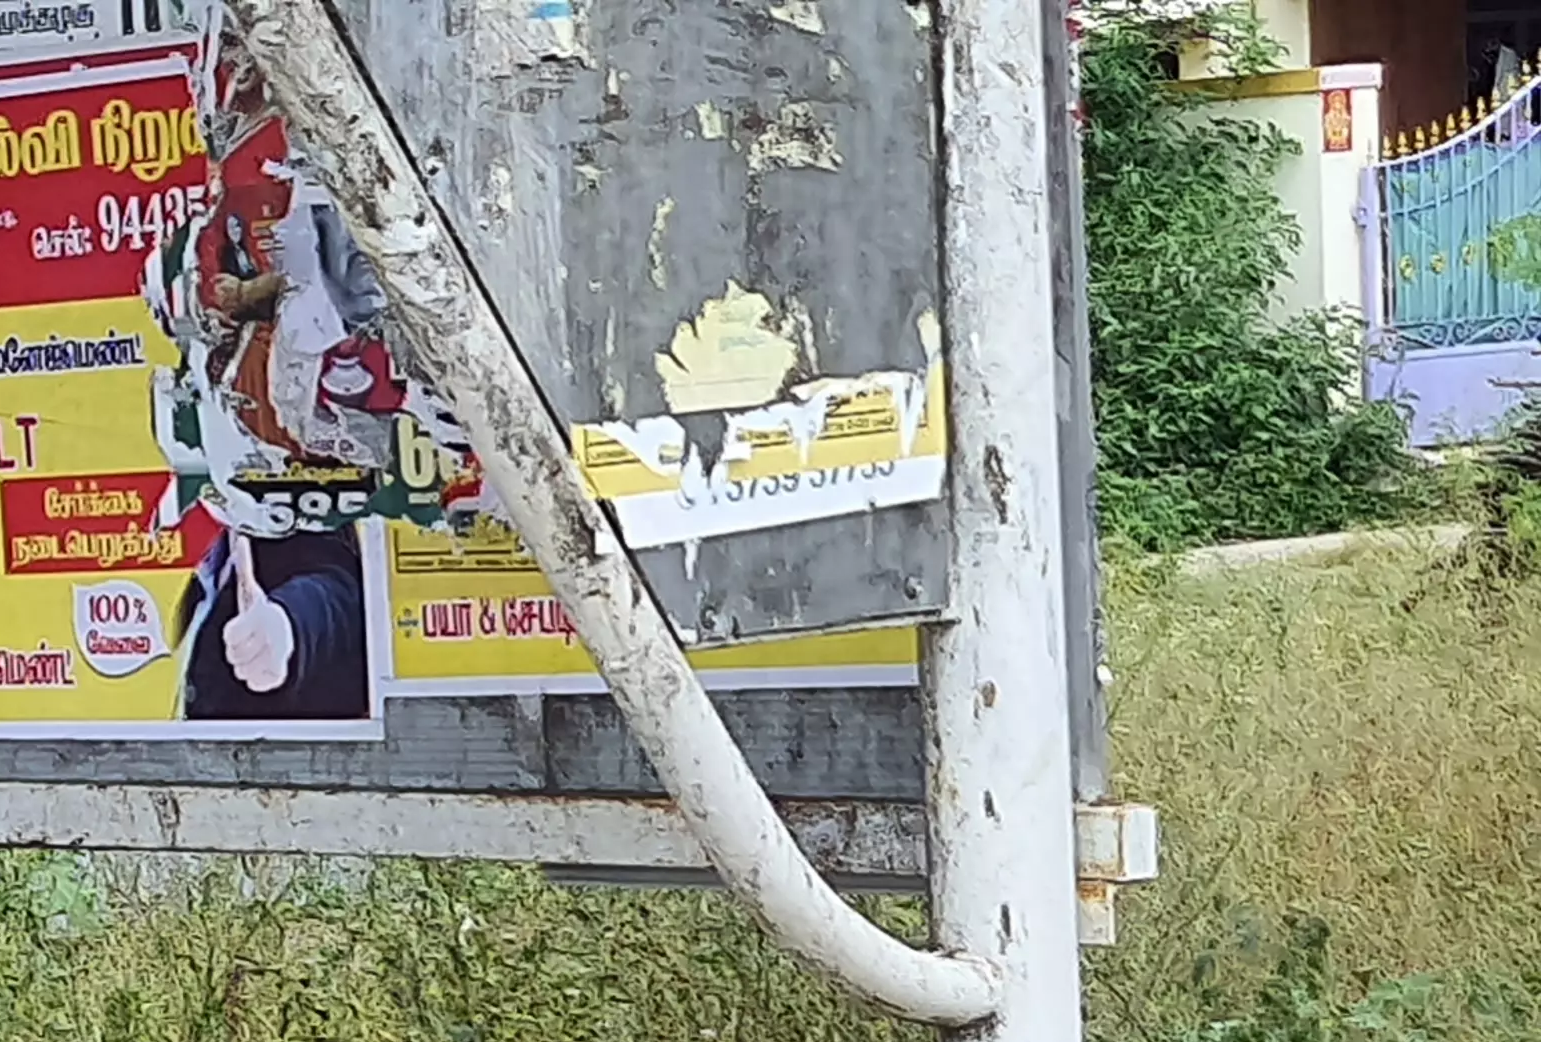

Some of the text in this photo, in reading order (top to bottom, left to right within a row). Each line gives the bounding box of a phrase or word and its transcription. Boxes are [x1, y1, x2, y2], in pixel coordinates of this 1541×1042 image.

[44, 480, 144, 521] சேர்க்கை
[12, 526, 183, 570] நடைபெறுகிறது
[88, 593, 149, 625] 100 %
[478, 599, 498, 637] &
[86, 630, 151, 657] வேலை
